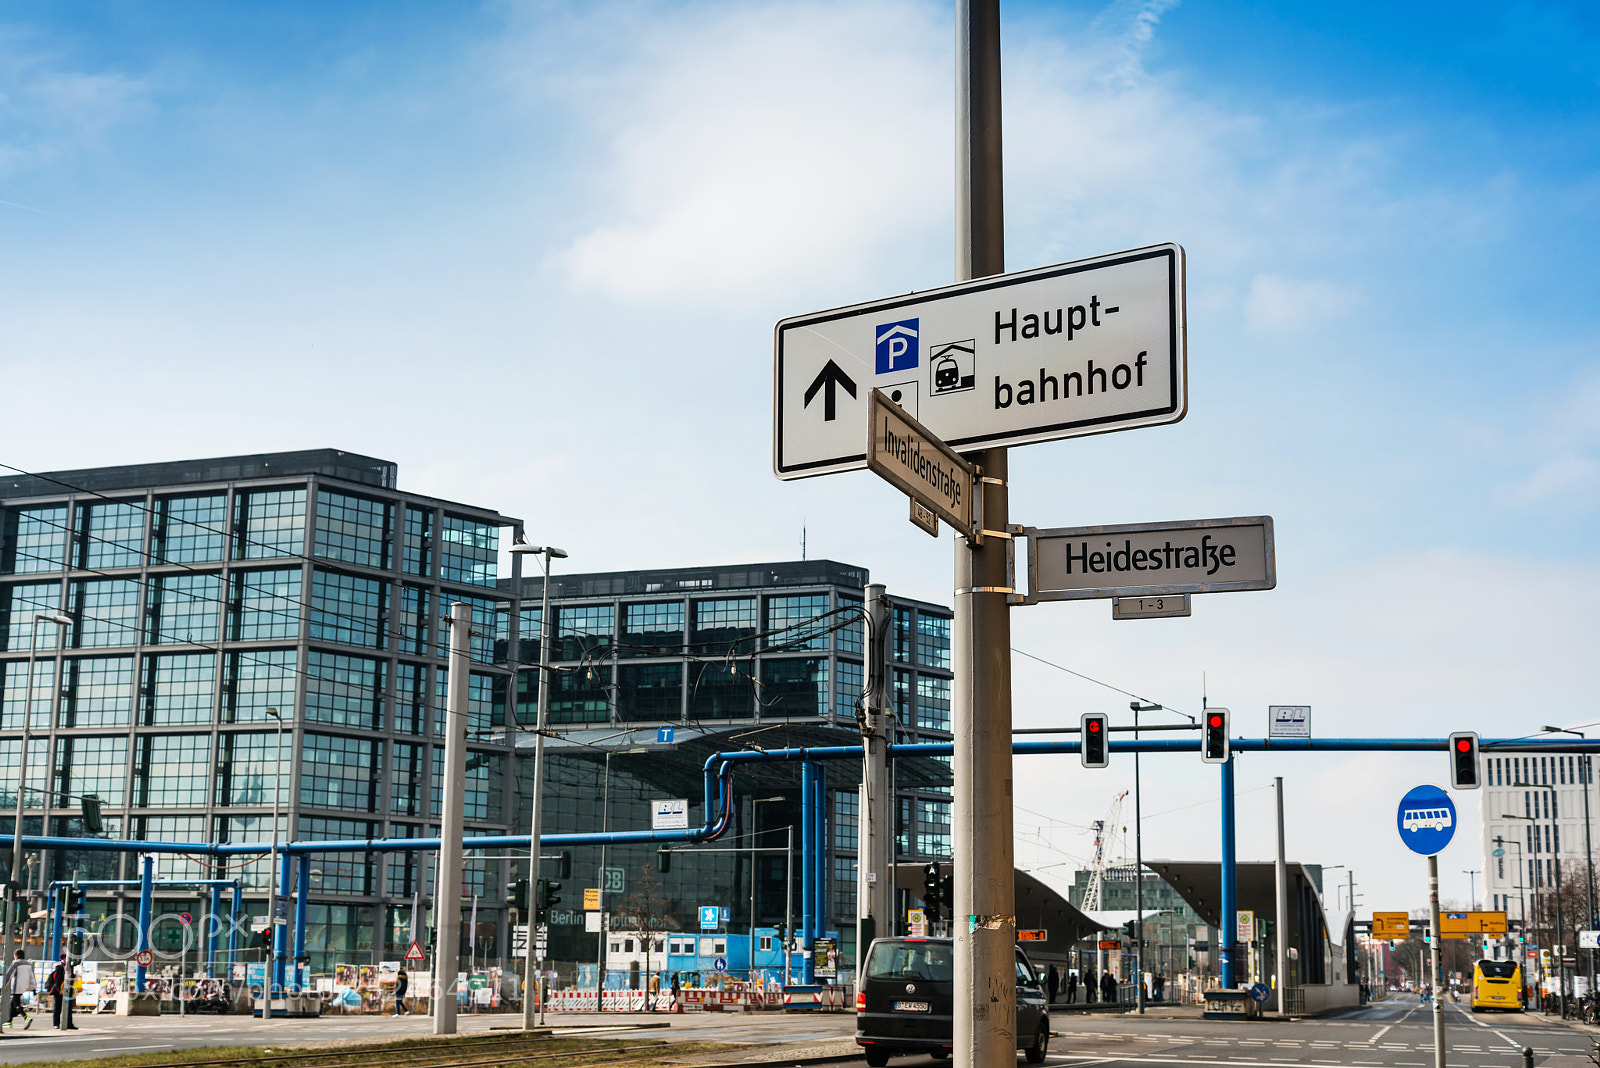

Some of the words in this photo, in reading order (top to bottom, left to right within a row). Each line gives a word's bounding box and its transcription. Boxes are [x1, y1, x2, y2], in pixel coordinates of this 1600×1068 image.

[994, 295, 1120, 345] Haupt-
[888, 337, 908, 370] P
[994, 351, 1148, 409] bahnhof
[884, 415, 961, 509] Invalidenstraße
[1066, 535, 1236, 576] Heidestraße
[550, 910, 584, 925] Berlin
